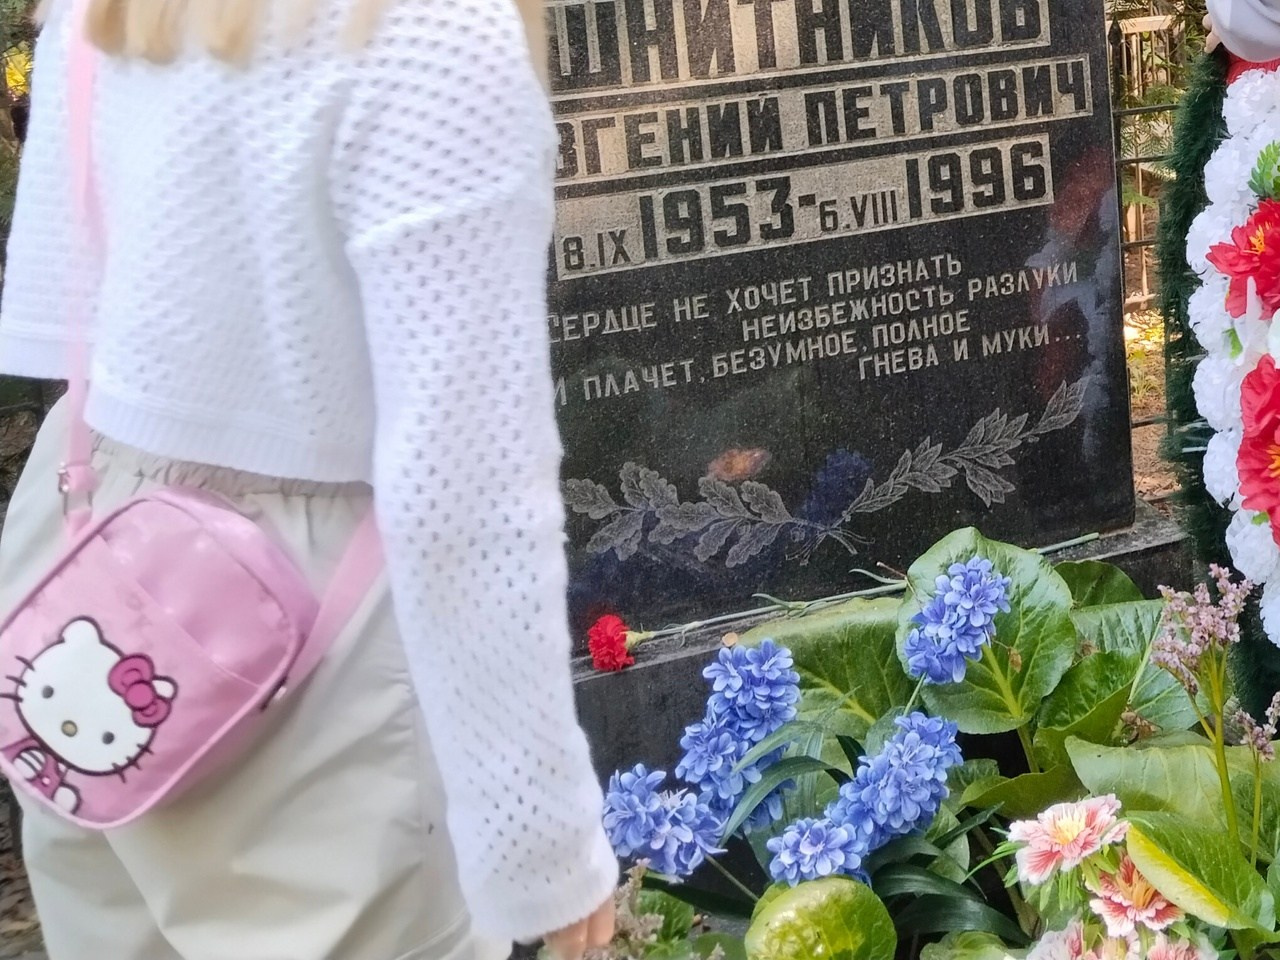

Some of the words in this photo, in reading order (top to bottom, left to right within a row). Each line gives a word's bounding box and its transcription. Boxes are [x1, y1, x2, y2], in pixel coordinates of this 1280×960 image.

[554, 93, 783, 177] ВГЕНИЙ
[804, 60, 1087, 147] ПЕТРОВИЧ
[906, 140, 1047, 220] 1996
[547, 302, 658, 344] СЕРДЦЕ
[673, 294, 710, 323] НЕ
[726, 276, 812, 315] ХОЧЕТ
[827, 253, 962, 297] ПРИЗНАТЬ
[741, 284, 954, 341] НЕИЗБЕЖНОСТЬ
[967, 261, 1078, 302] РАЗЛУКИ
[584, 359, 706, 401] ПЛАЧЕТ,
[712, 330, 868, 378] БЕЗУМНОЕ,
[872, 309, 971, 349] ПОЛНОЕ
[858, 343, 939, 381] ГНЕВА
[953, 337, 970, 362] И
[982, 324, 1081, 358] МУКИ...
